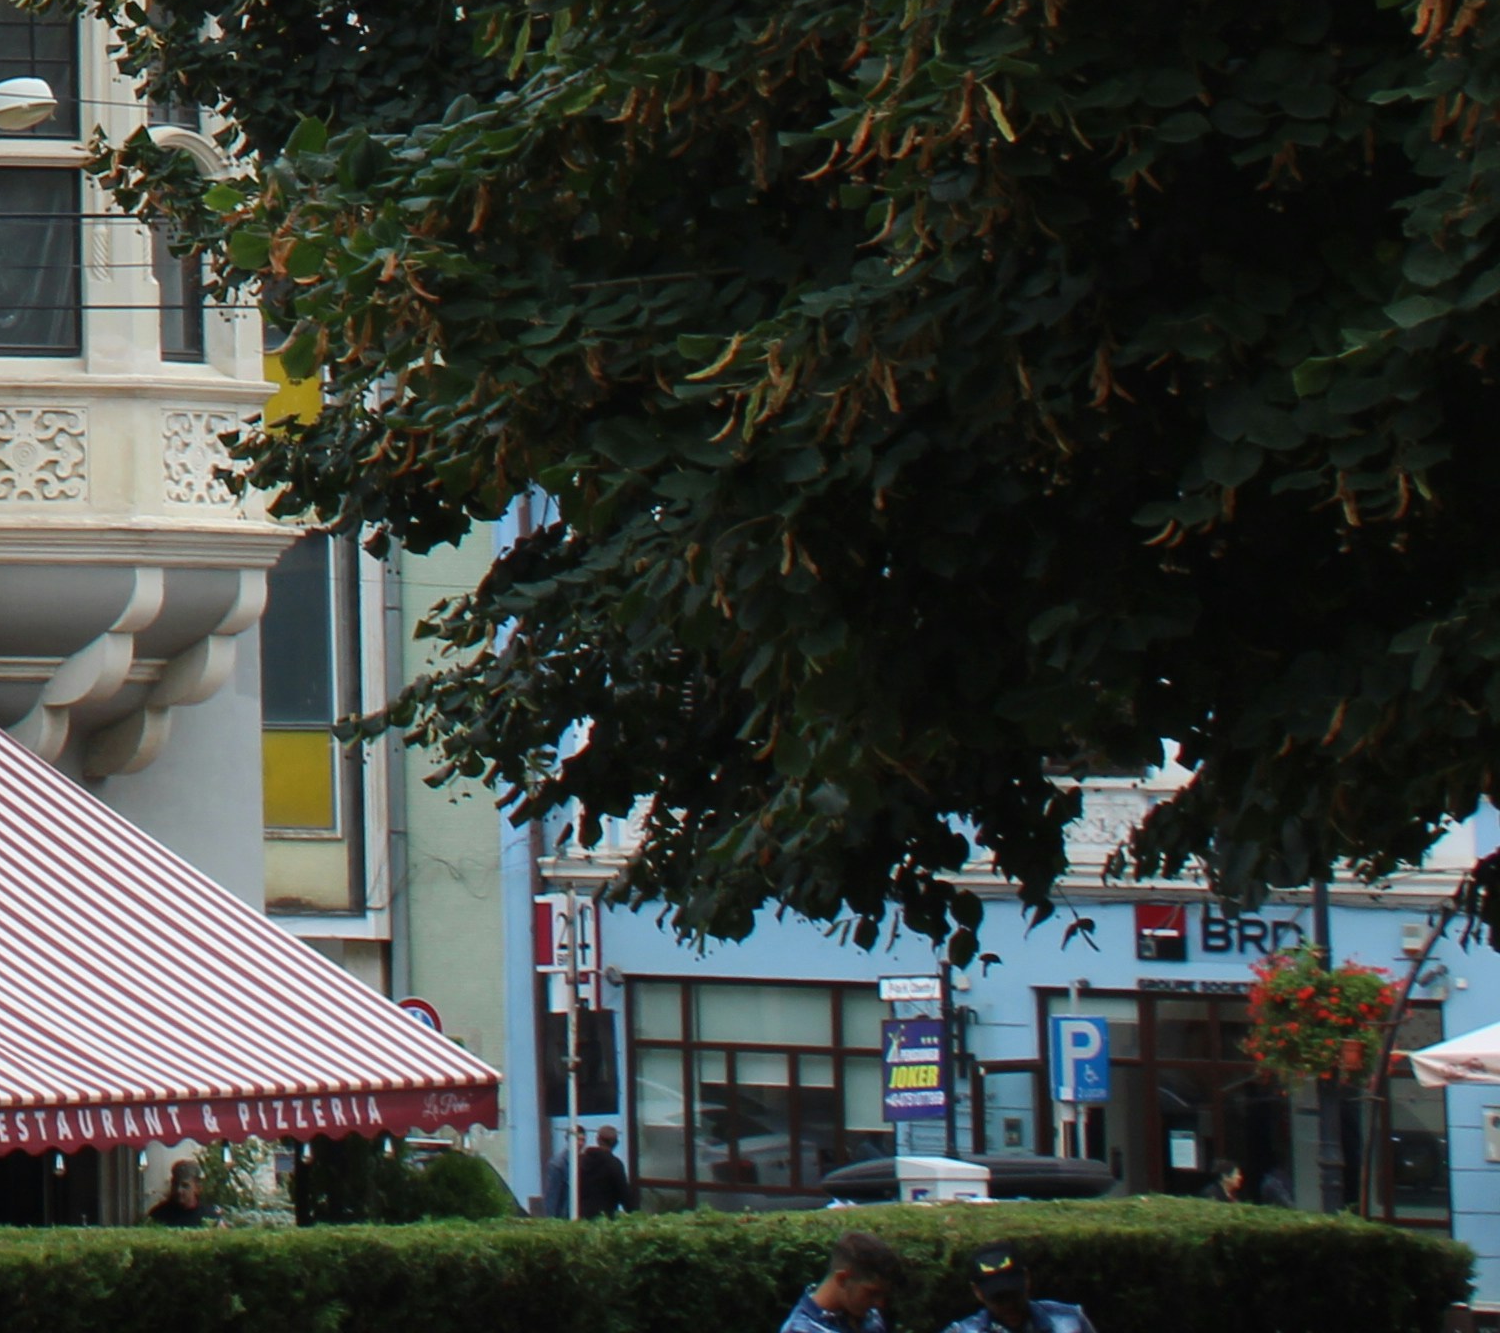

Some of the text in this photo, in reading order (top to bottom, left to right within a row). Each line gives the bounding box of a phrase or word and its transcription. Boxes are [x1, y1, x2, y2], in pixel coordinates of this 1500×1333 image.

[889, 1064, 940, 1089] JOKER
[1060, 1020, 1101, 1099] P
[202, 1103, 221, 1133] &
[238, 1096, 383, 1131] PIZZERIA
